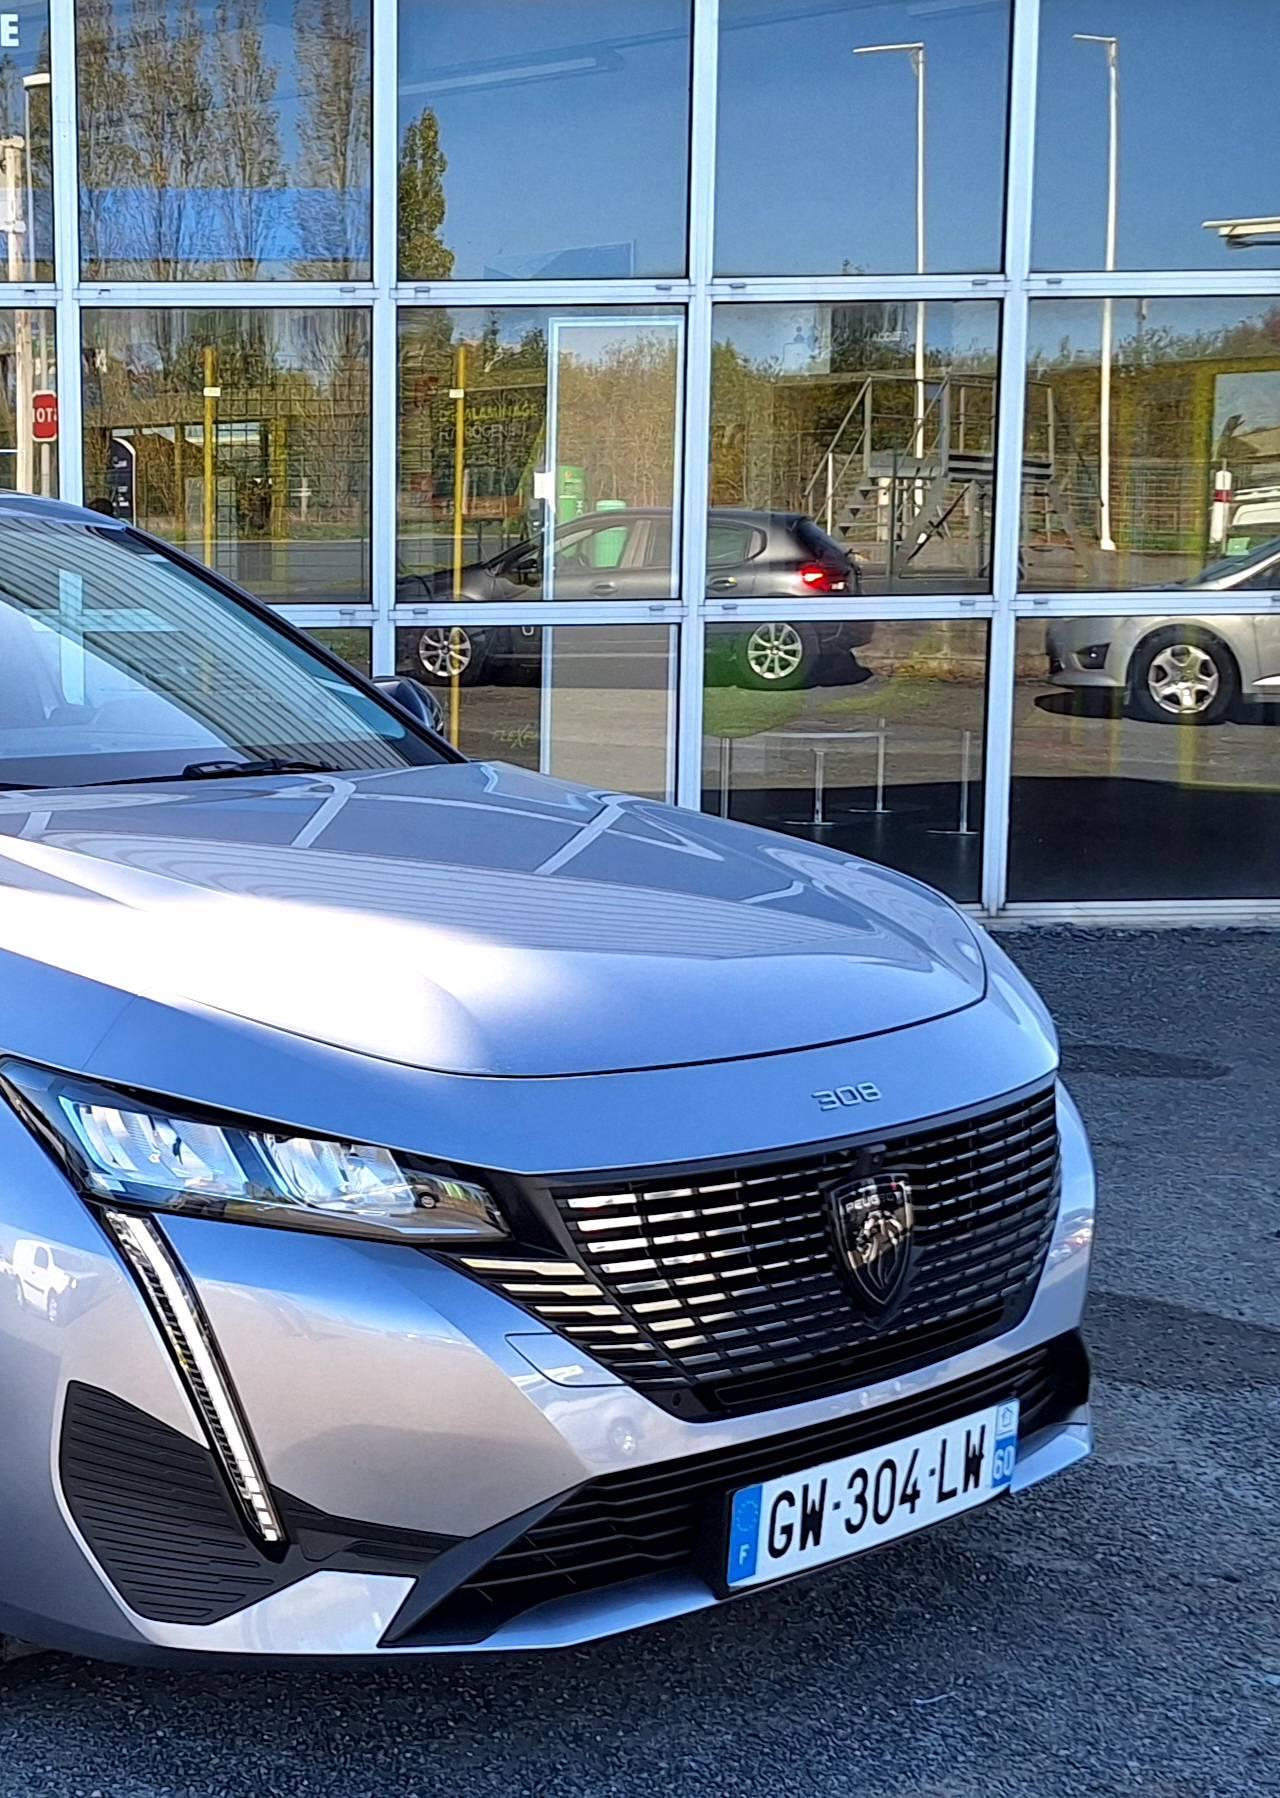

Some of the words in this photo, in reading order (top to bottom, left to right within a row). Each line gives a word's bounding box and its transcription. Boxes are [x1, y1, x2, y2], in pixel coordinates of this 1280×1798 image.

[811, 1082, 882, 1111] 308
[739, 1544, 749, 1564] F
[767, 1425, 987, 1559] GW-304-LW
[993, 1445, 1015, 1479] 60
